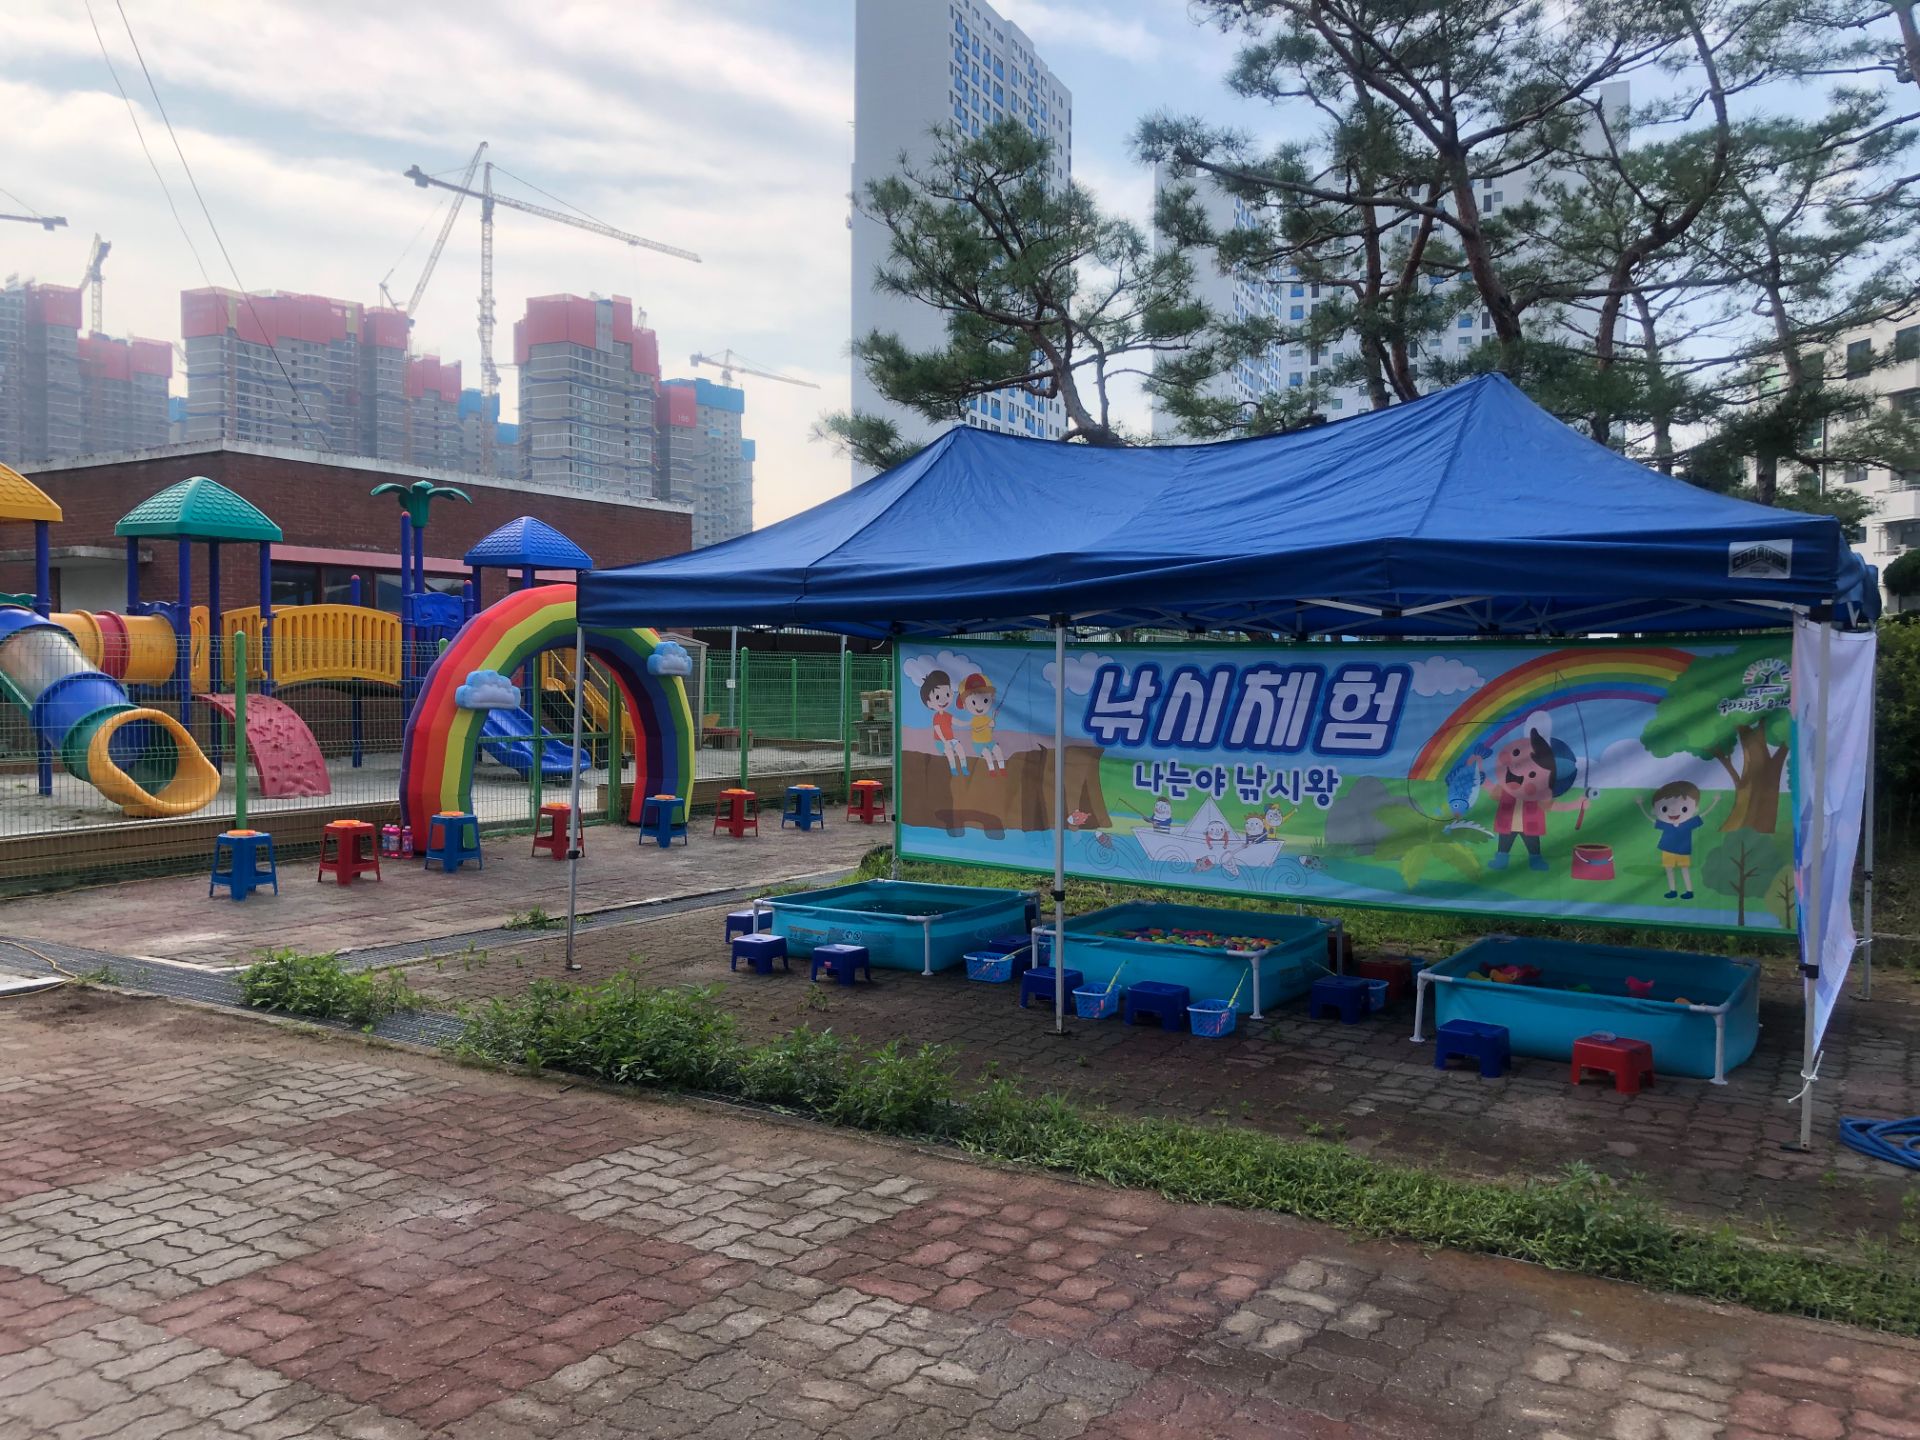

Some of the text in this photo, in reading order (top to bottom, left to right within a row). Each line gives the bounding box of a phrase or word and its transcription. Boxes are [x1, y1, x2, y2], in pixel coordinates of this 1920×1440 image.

[1087, 667, 1405, 753] 낚시체험
[1134, 762, 1340, 808] 나는야 낚시왕
